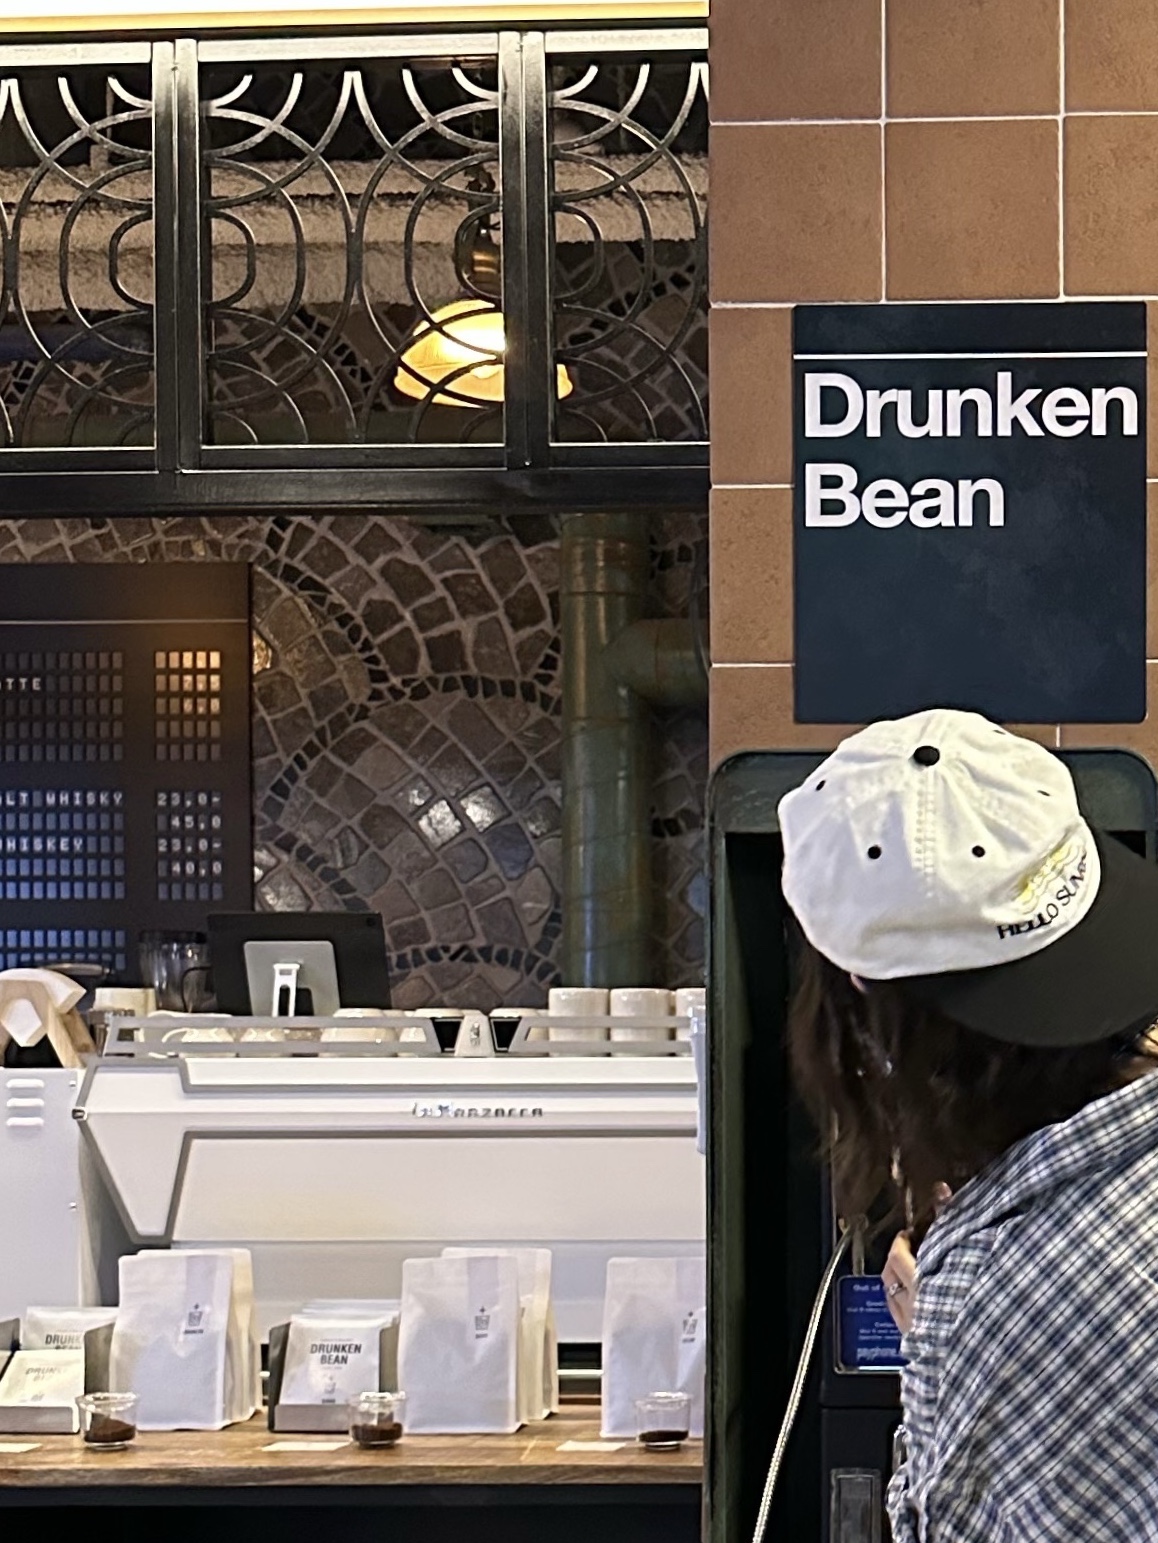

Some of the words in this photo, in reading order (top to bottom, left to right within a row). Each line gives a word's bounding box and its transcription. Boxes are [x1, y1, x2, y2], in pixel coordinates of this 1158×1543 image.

[804, 371, 1139, 438] Drunken
[804, 462, 1005, 528] Bean
[0, 677, 41, 690] TTE
[0, 791, 28, 806] LT
[46, 791, 122, 806] WHISKY
[0, 837, 83, 852] HISKEY
[309, 1343, 363, 1354] DRUNKEN
[320, 1354, 349, 1365] BEAN
